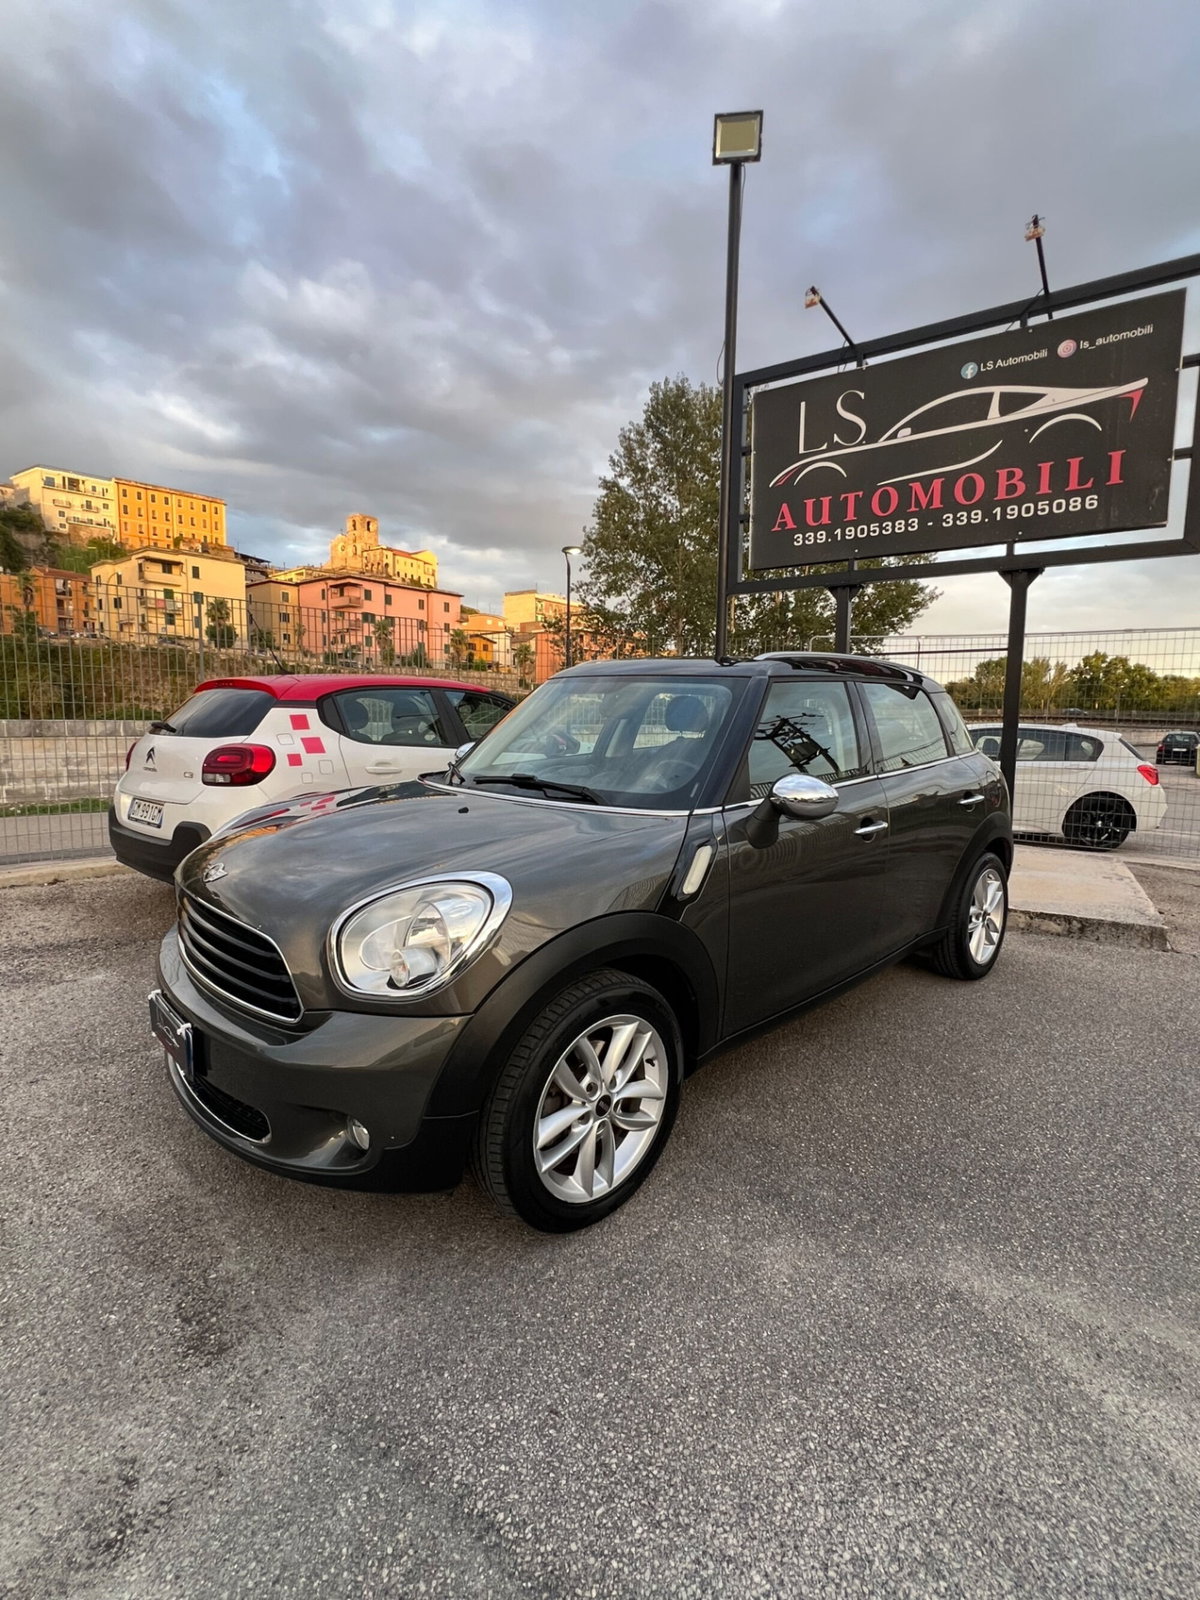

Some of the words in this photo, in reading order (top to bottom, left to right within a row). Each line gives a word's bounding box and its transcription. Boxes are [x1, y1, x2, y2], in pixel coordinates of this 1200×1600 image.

[980, 360, 994, 372] LS
[995, 348, 1048, 368] Automobili
[1079, 323, 1154, 350] ls_automobili
[798, 389, 867, 454] LS
[771, 449, 1127, 532] AUTOMOBILI
[793, 517, 919, 546] 339.1905383
[941, 494, 1099, 528] 339.1905086
